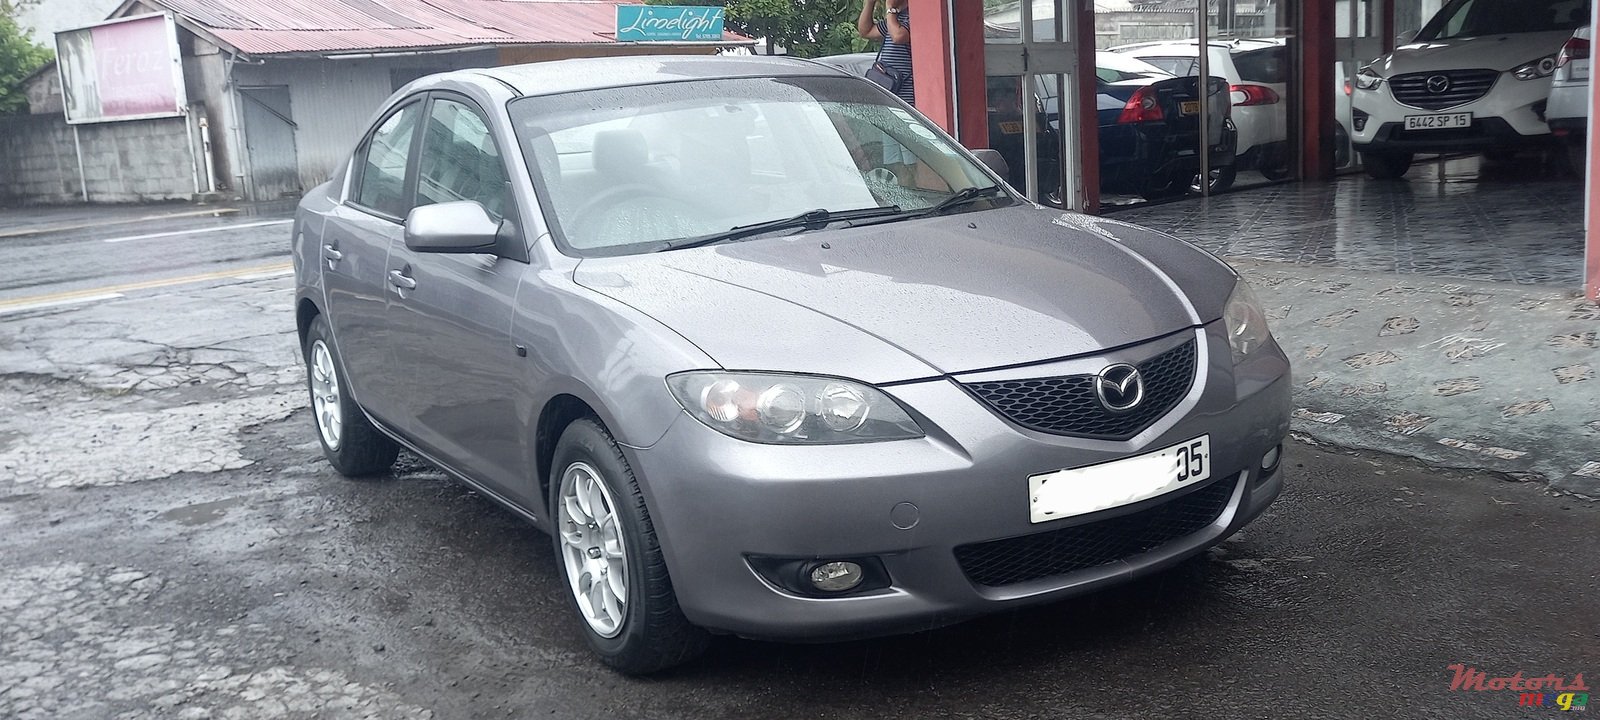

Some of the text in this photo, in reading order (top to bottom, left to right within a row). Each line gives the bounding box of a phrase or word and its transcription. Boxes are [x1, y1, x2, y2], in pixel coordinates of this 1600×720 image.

[620, 8, 722, 39] Limelight
[1409, 114, 1466, 129] 6442 SP 15
